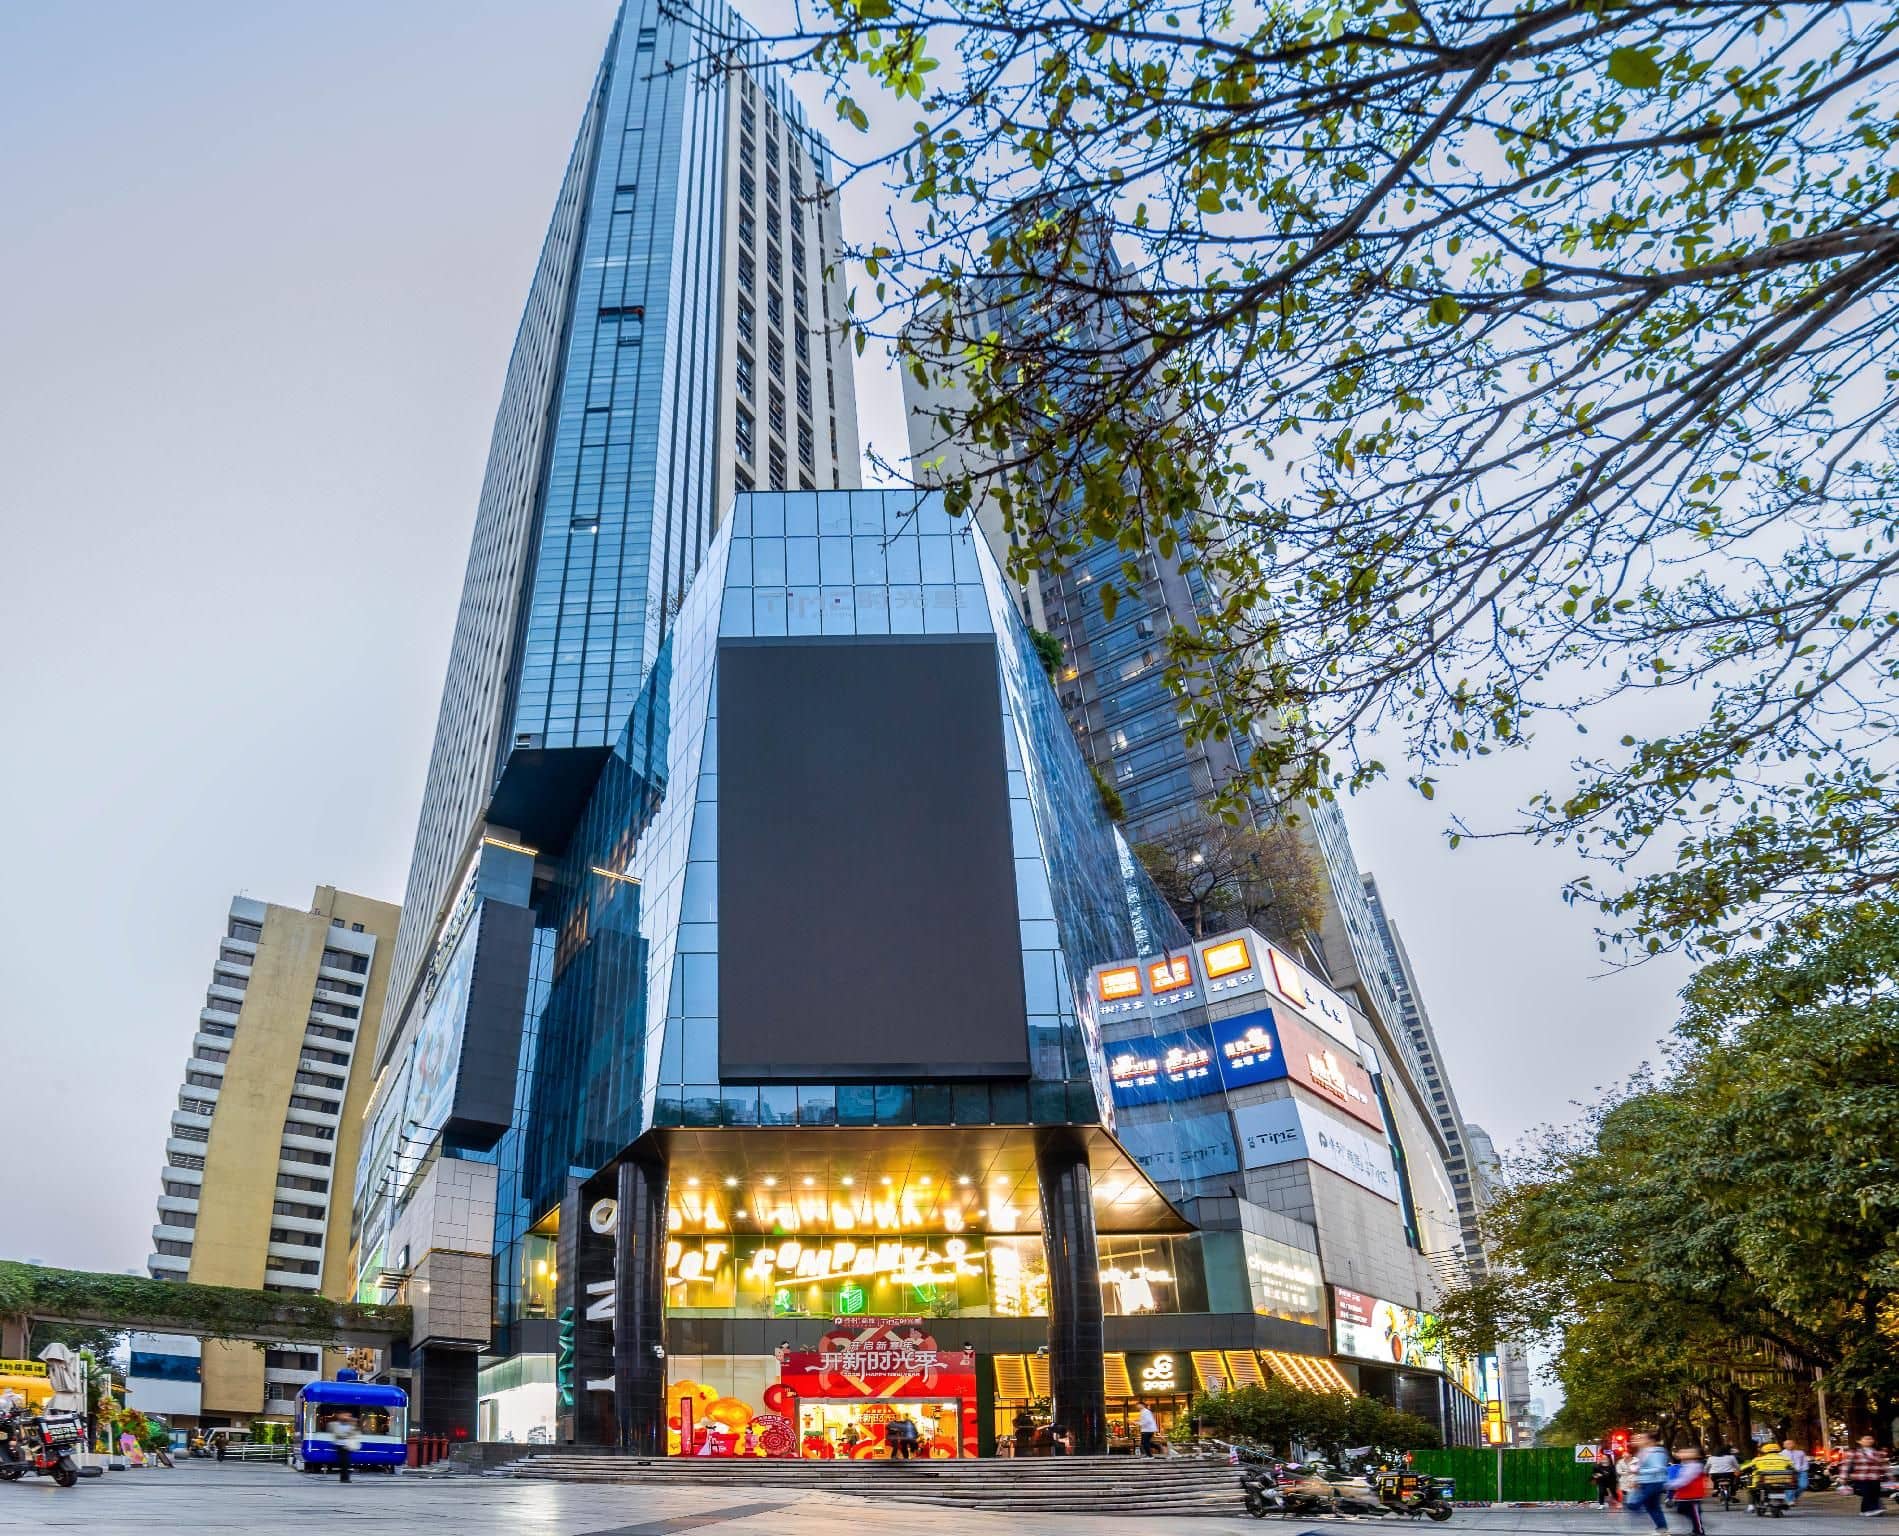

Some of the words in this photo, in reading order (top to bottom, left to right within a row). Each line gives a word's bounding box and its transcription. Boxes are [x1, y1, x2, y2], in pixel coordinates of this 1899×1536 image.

[812, 1350, 944, 1378] 开新时光季
